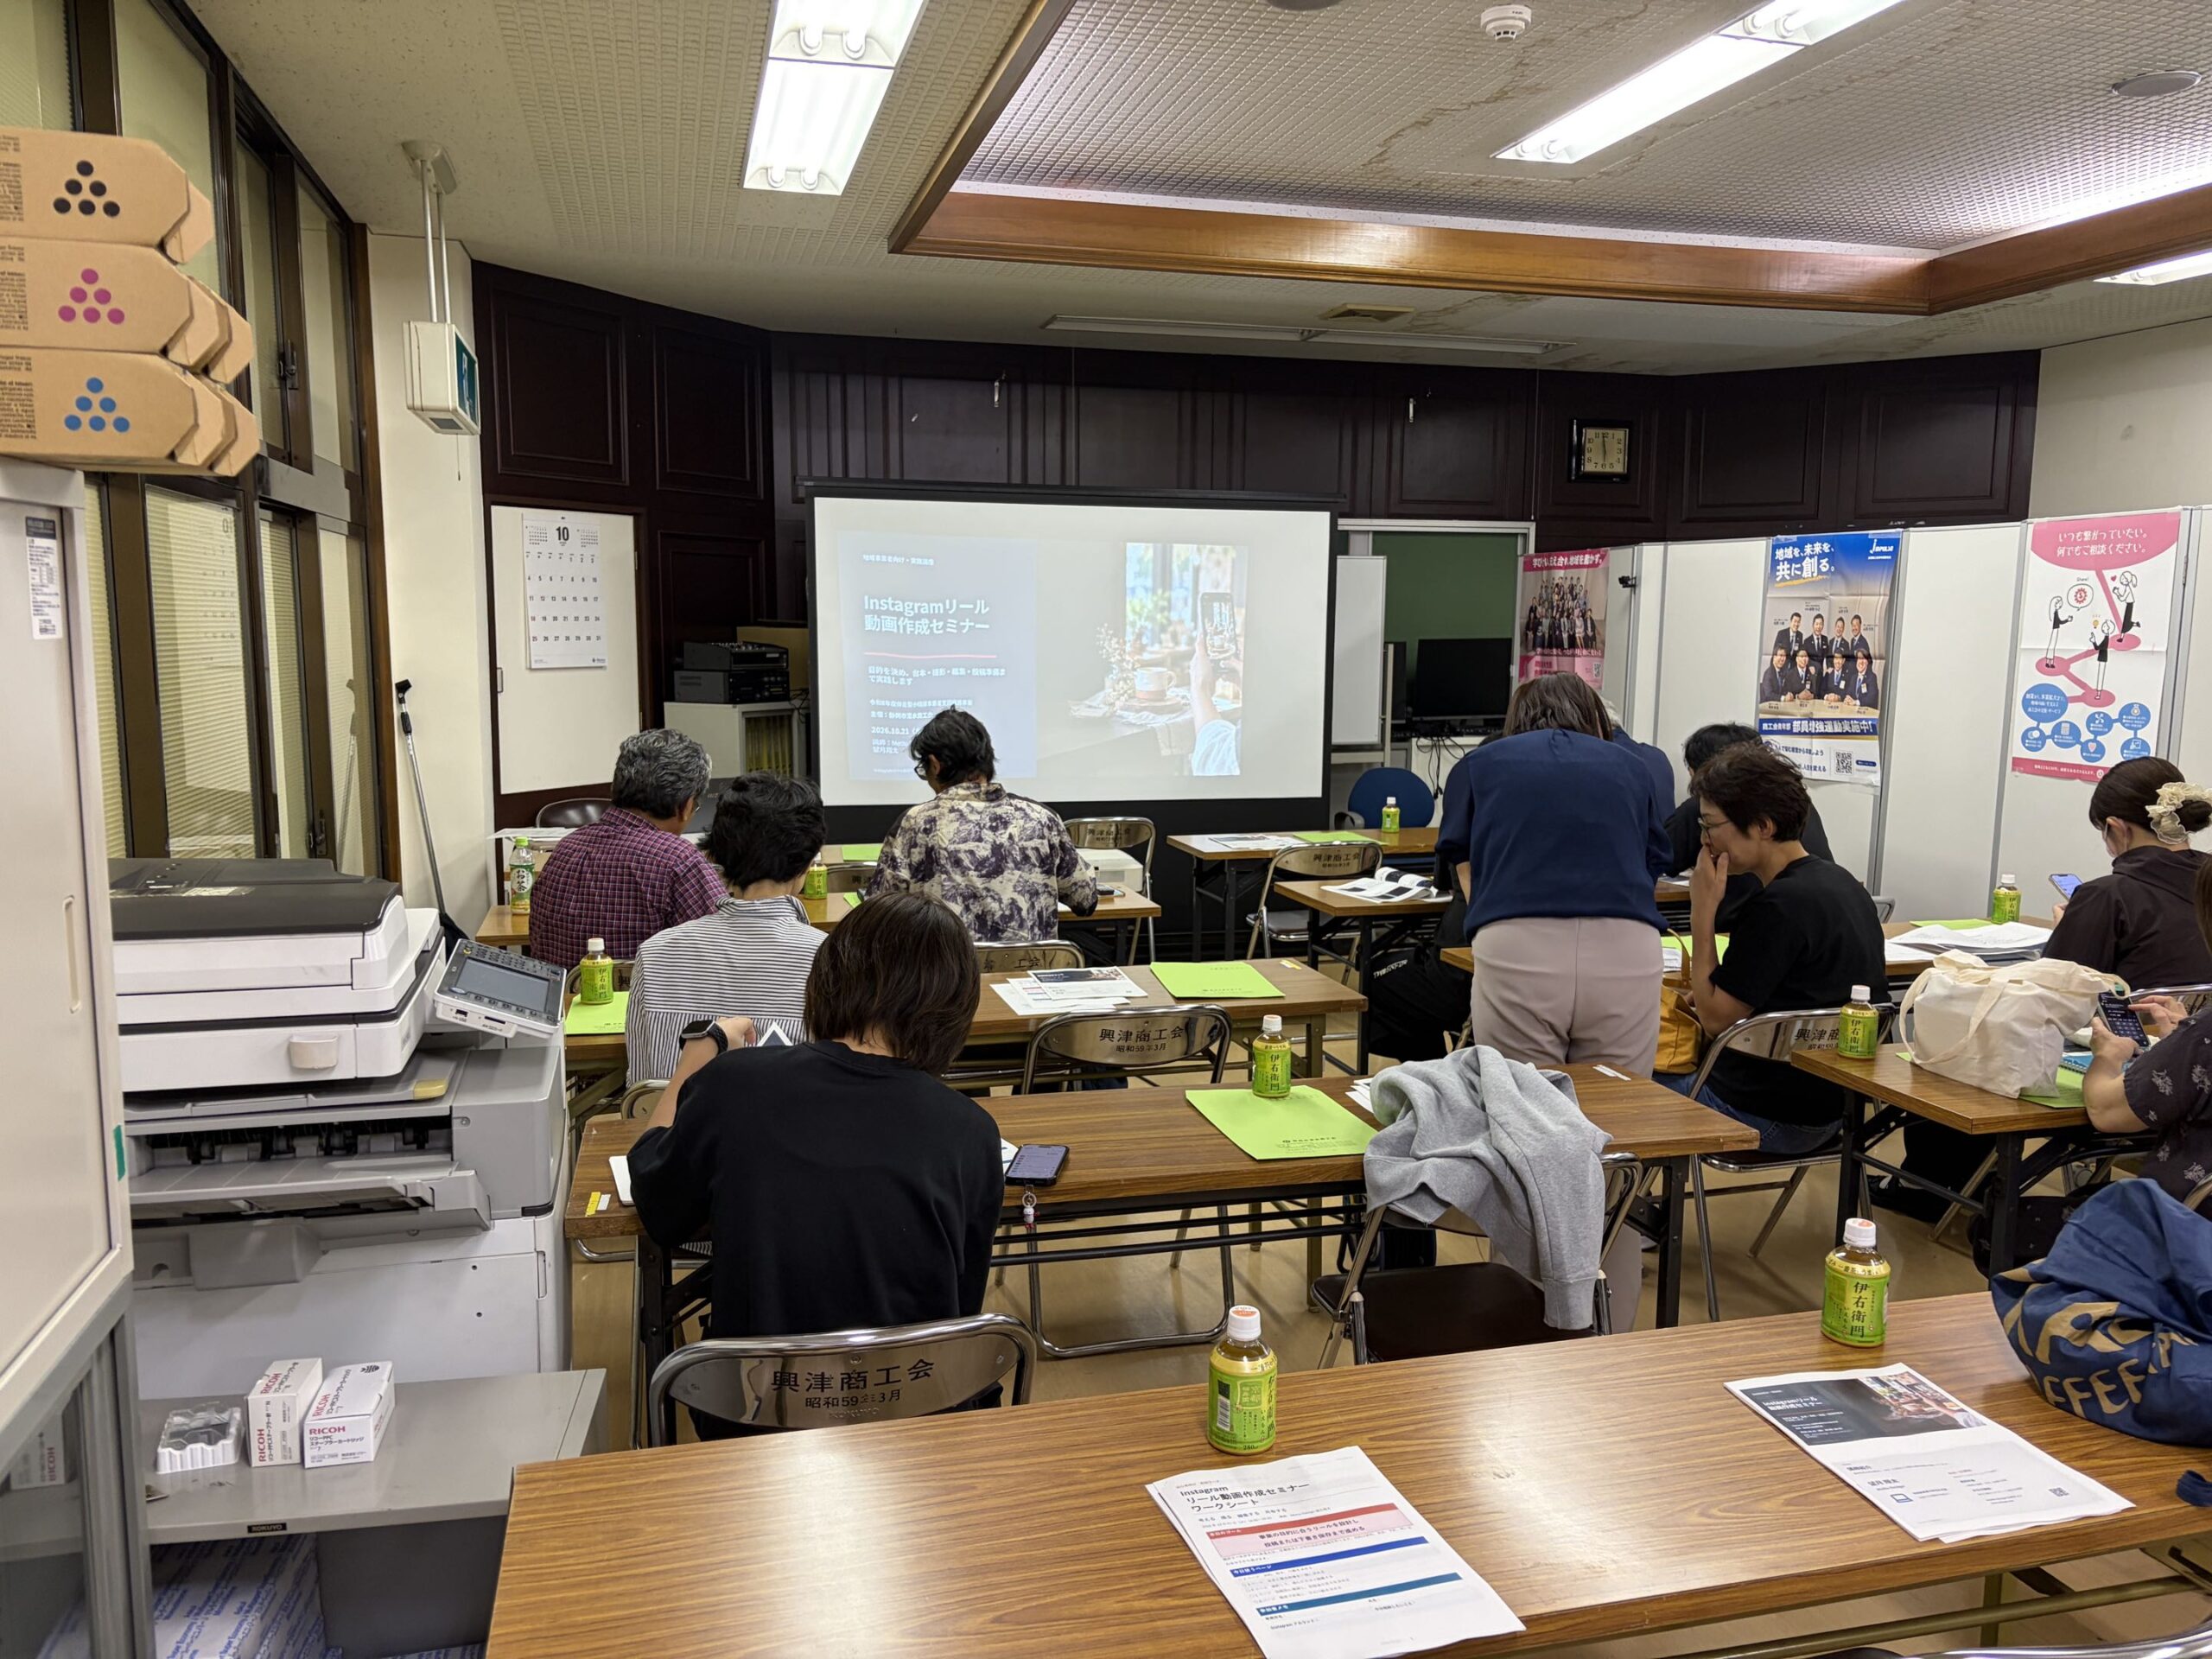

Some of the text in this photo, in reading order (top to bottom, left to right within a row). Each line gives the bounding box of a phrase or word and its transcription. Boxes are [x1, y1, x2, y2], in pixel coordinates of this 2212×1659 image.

[556, 526, 569, 542] 10
[2058, 528, 2148, 543] いつも繋がっていたい。
[1775, 542, 1834, 560] 地域を、未来を、
[2056, 543, 2147, 557] 何でもご相談ください。
[1776, 556, 1835, 582] 共に創る。
[864, 595, 989, 617] Instagramリール
[864, 614, 990, 635] 動画作成セミナー
[1099, 1026, 1185, 1043] 興津商工会
[1850, 1281, 1870, 1338] 伊右衛門
[771, 1358, 935, 1393] 興津商工会
[309, 1426, 346, 1435] RICOH
[1180, 1485, 1229, 1497] Instagram
[1186, 1483, 1310, 1504] リール動画作成セミナー
[1191, 1499, 1259, 1512] ワークシート
